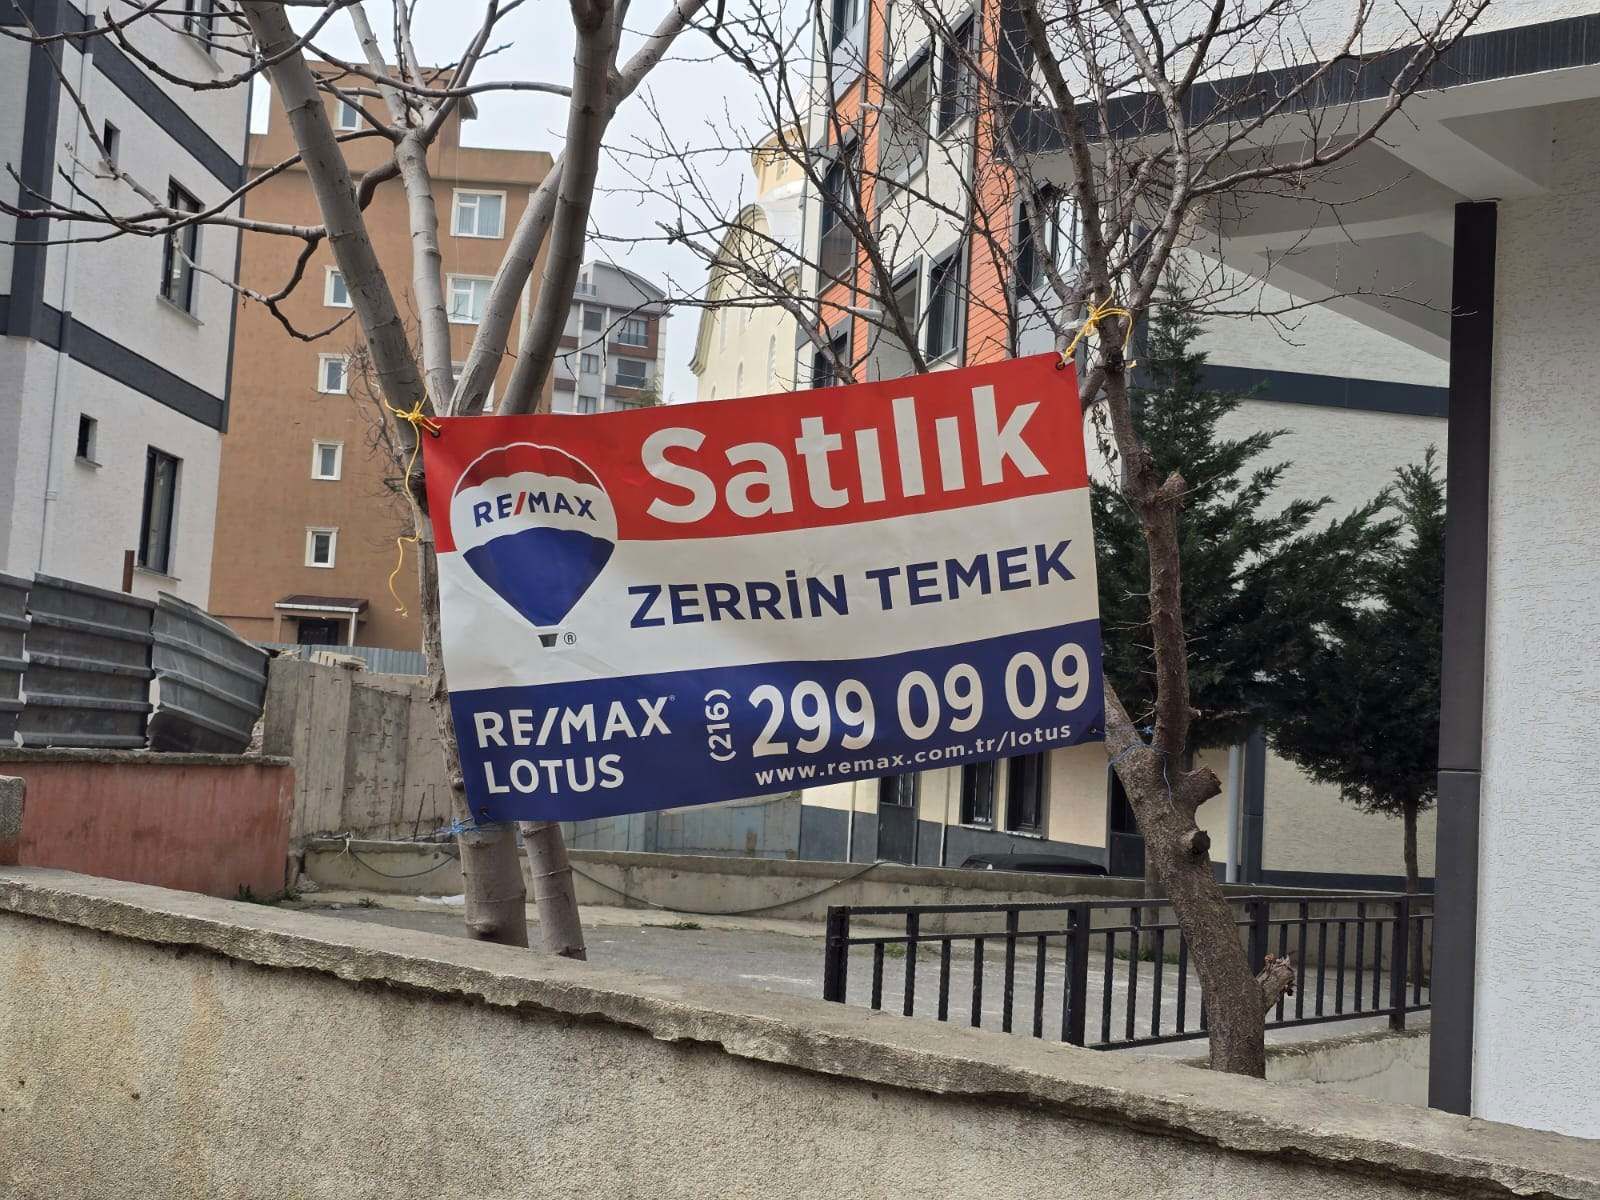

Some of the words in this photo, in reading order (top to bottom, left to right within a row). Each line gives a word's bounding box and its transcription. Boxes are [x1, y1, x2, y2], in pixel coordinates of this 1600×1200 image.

[641, 384, 1049, 523] Satılık
[473, 491, 597, 527] RE/MAX
[628, 569, 849, 629] ZERRİN
[865, 539, 1075, 611] TEMEK
[473, 696, 672, 748] RE/MAX
[704, 689, 737, 762] (216)
[748, 679, 876, 758] 299
[897, 663, 984, 741] 09
[1005, 643, 1090, 721] 09
[484, 754, 624, 794] LOTUS
[754, 723, 1072, 786] www.remax.com.tr/lotus
